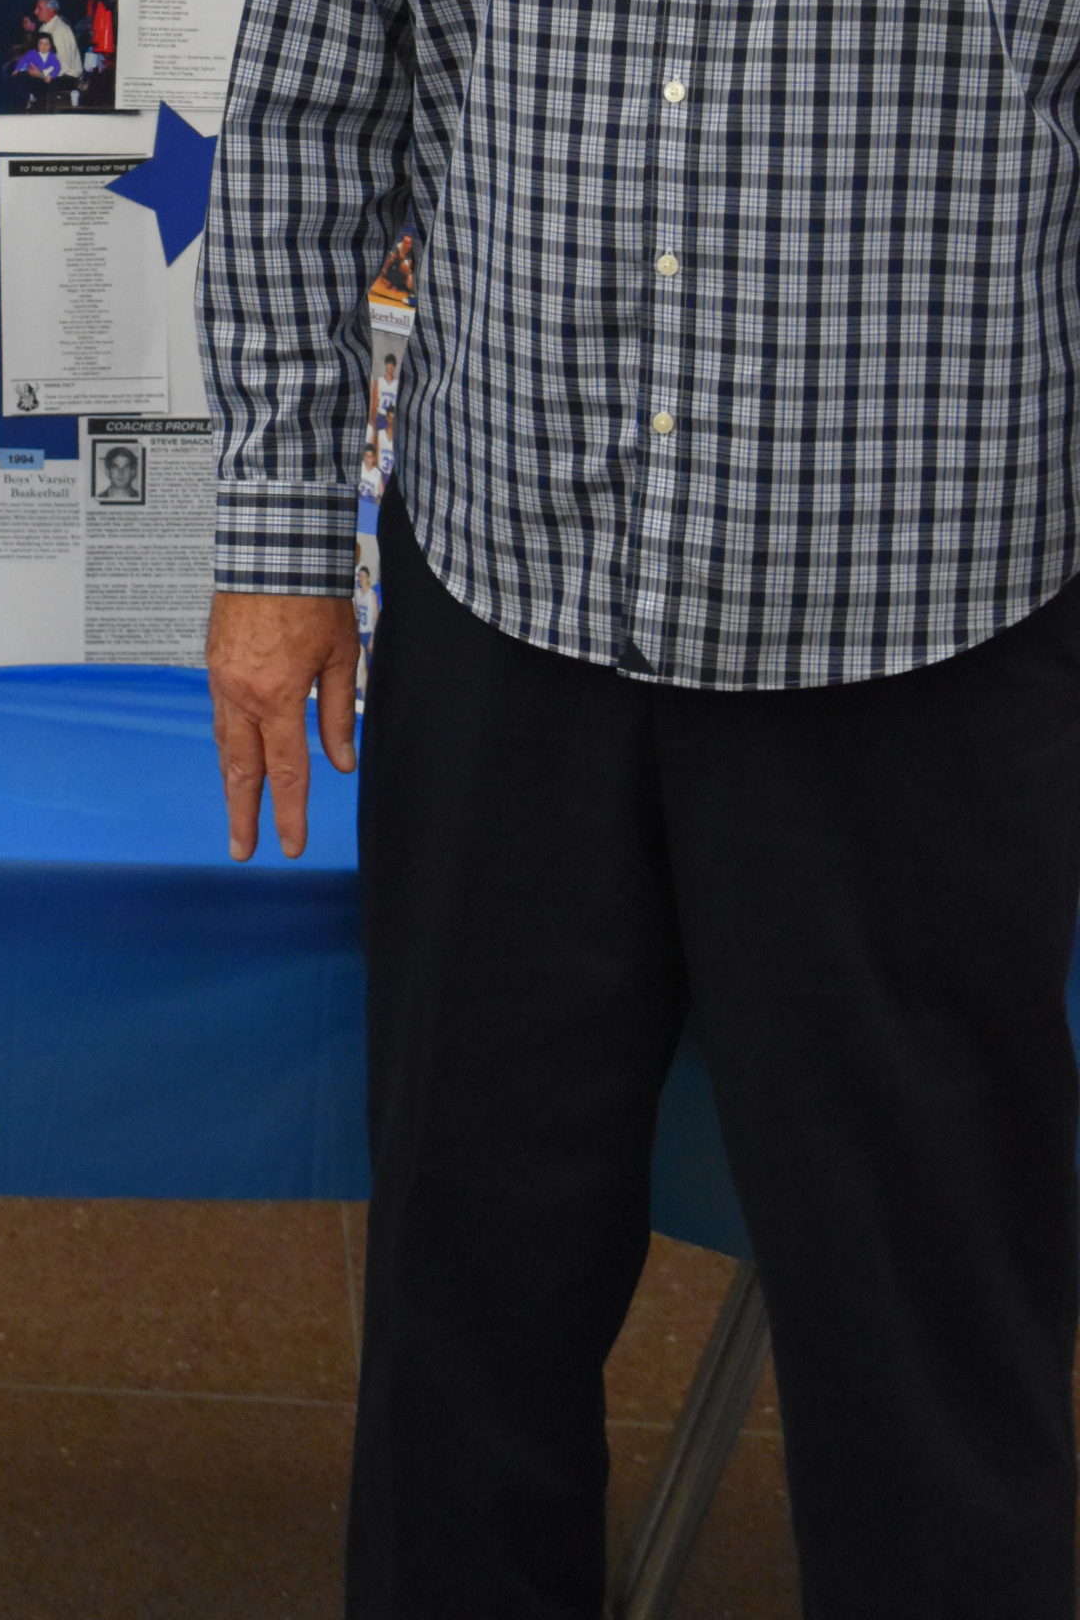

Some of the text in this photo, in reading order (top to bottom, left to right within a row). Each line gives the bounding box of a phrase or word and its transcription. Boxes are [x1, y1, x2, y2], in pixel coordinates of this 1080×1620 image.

[370, 312, 411, 327] ketball
[106, 421, 162, 431] COACHES
[9, 454, 34, 464] 1994
[38, 474, 77, 484] Varsity
[11, 488, 69, 498] Basketball
